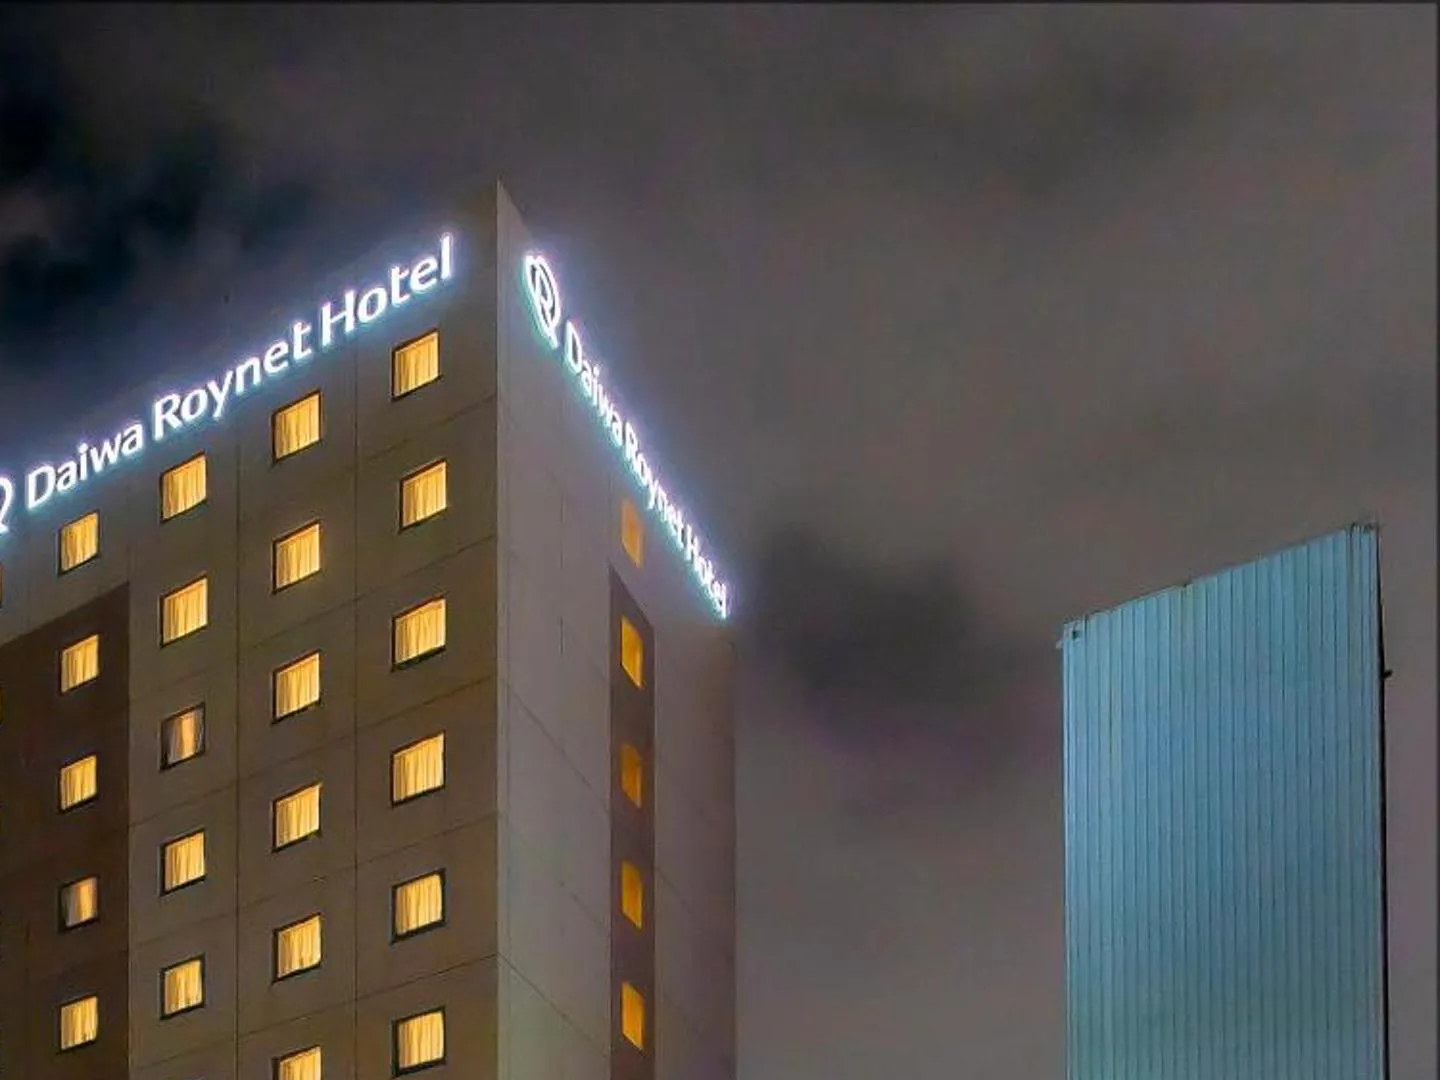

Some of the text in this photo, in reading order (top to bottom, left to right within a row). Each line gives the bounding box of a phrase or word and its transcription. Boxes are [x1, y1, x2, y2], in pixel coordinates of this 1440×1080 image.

[25, 421, 143, 510] Daiwa
[154, 320, 312, 440] Roynet
[321, 233, 452, 348] Hotel
[565, 321, 623, 447] Daiwa
